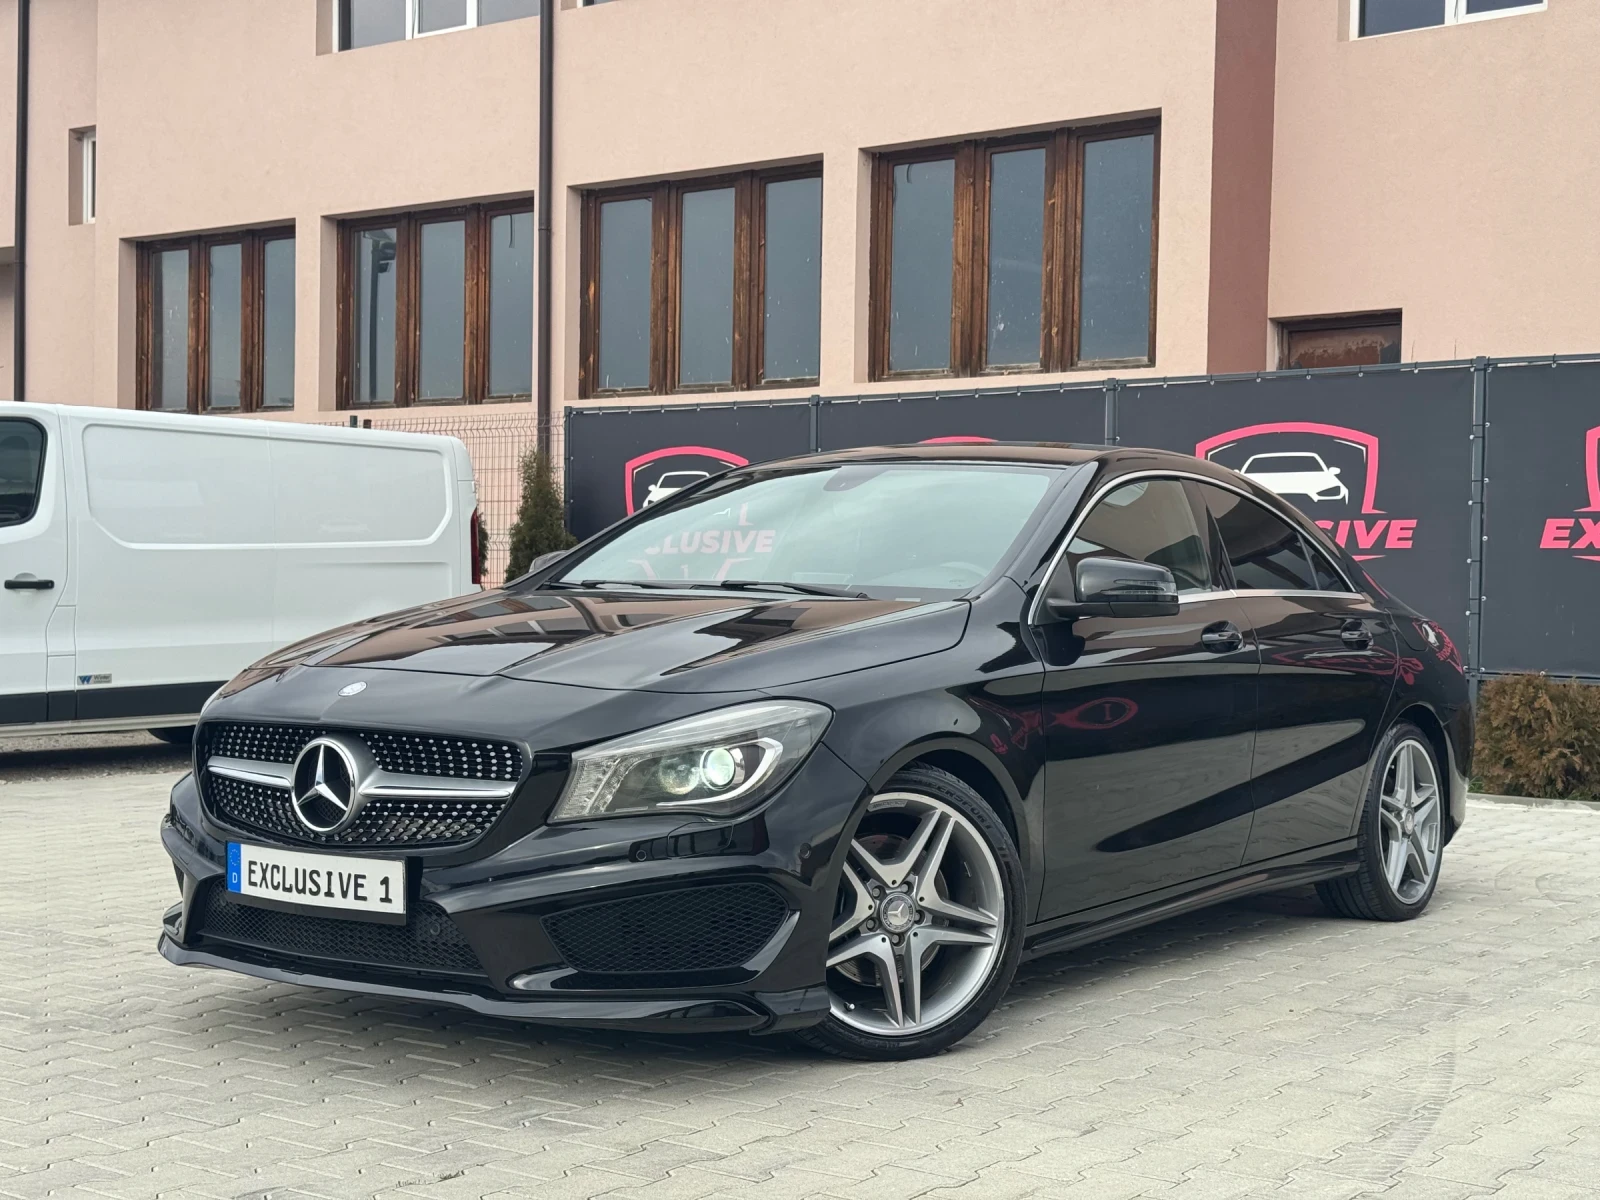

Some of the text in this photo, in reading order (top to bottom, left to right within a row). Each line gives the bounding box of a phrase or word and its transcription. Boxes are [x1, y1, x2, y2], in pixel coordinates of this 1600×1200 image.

[645, 530, 776, 554] LUSIVE
[232, 872, 238, 884] D
[248, 860, 393, 904] EXCLUSIVE 1
